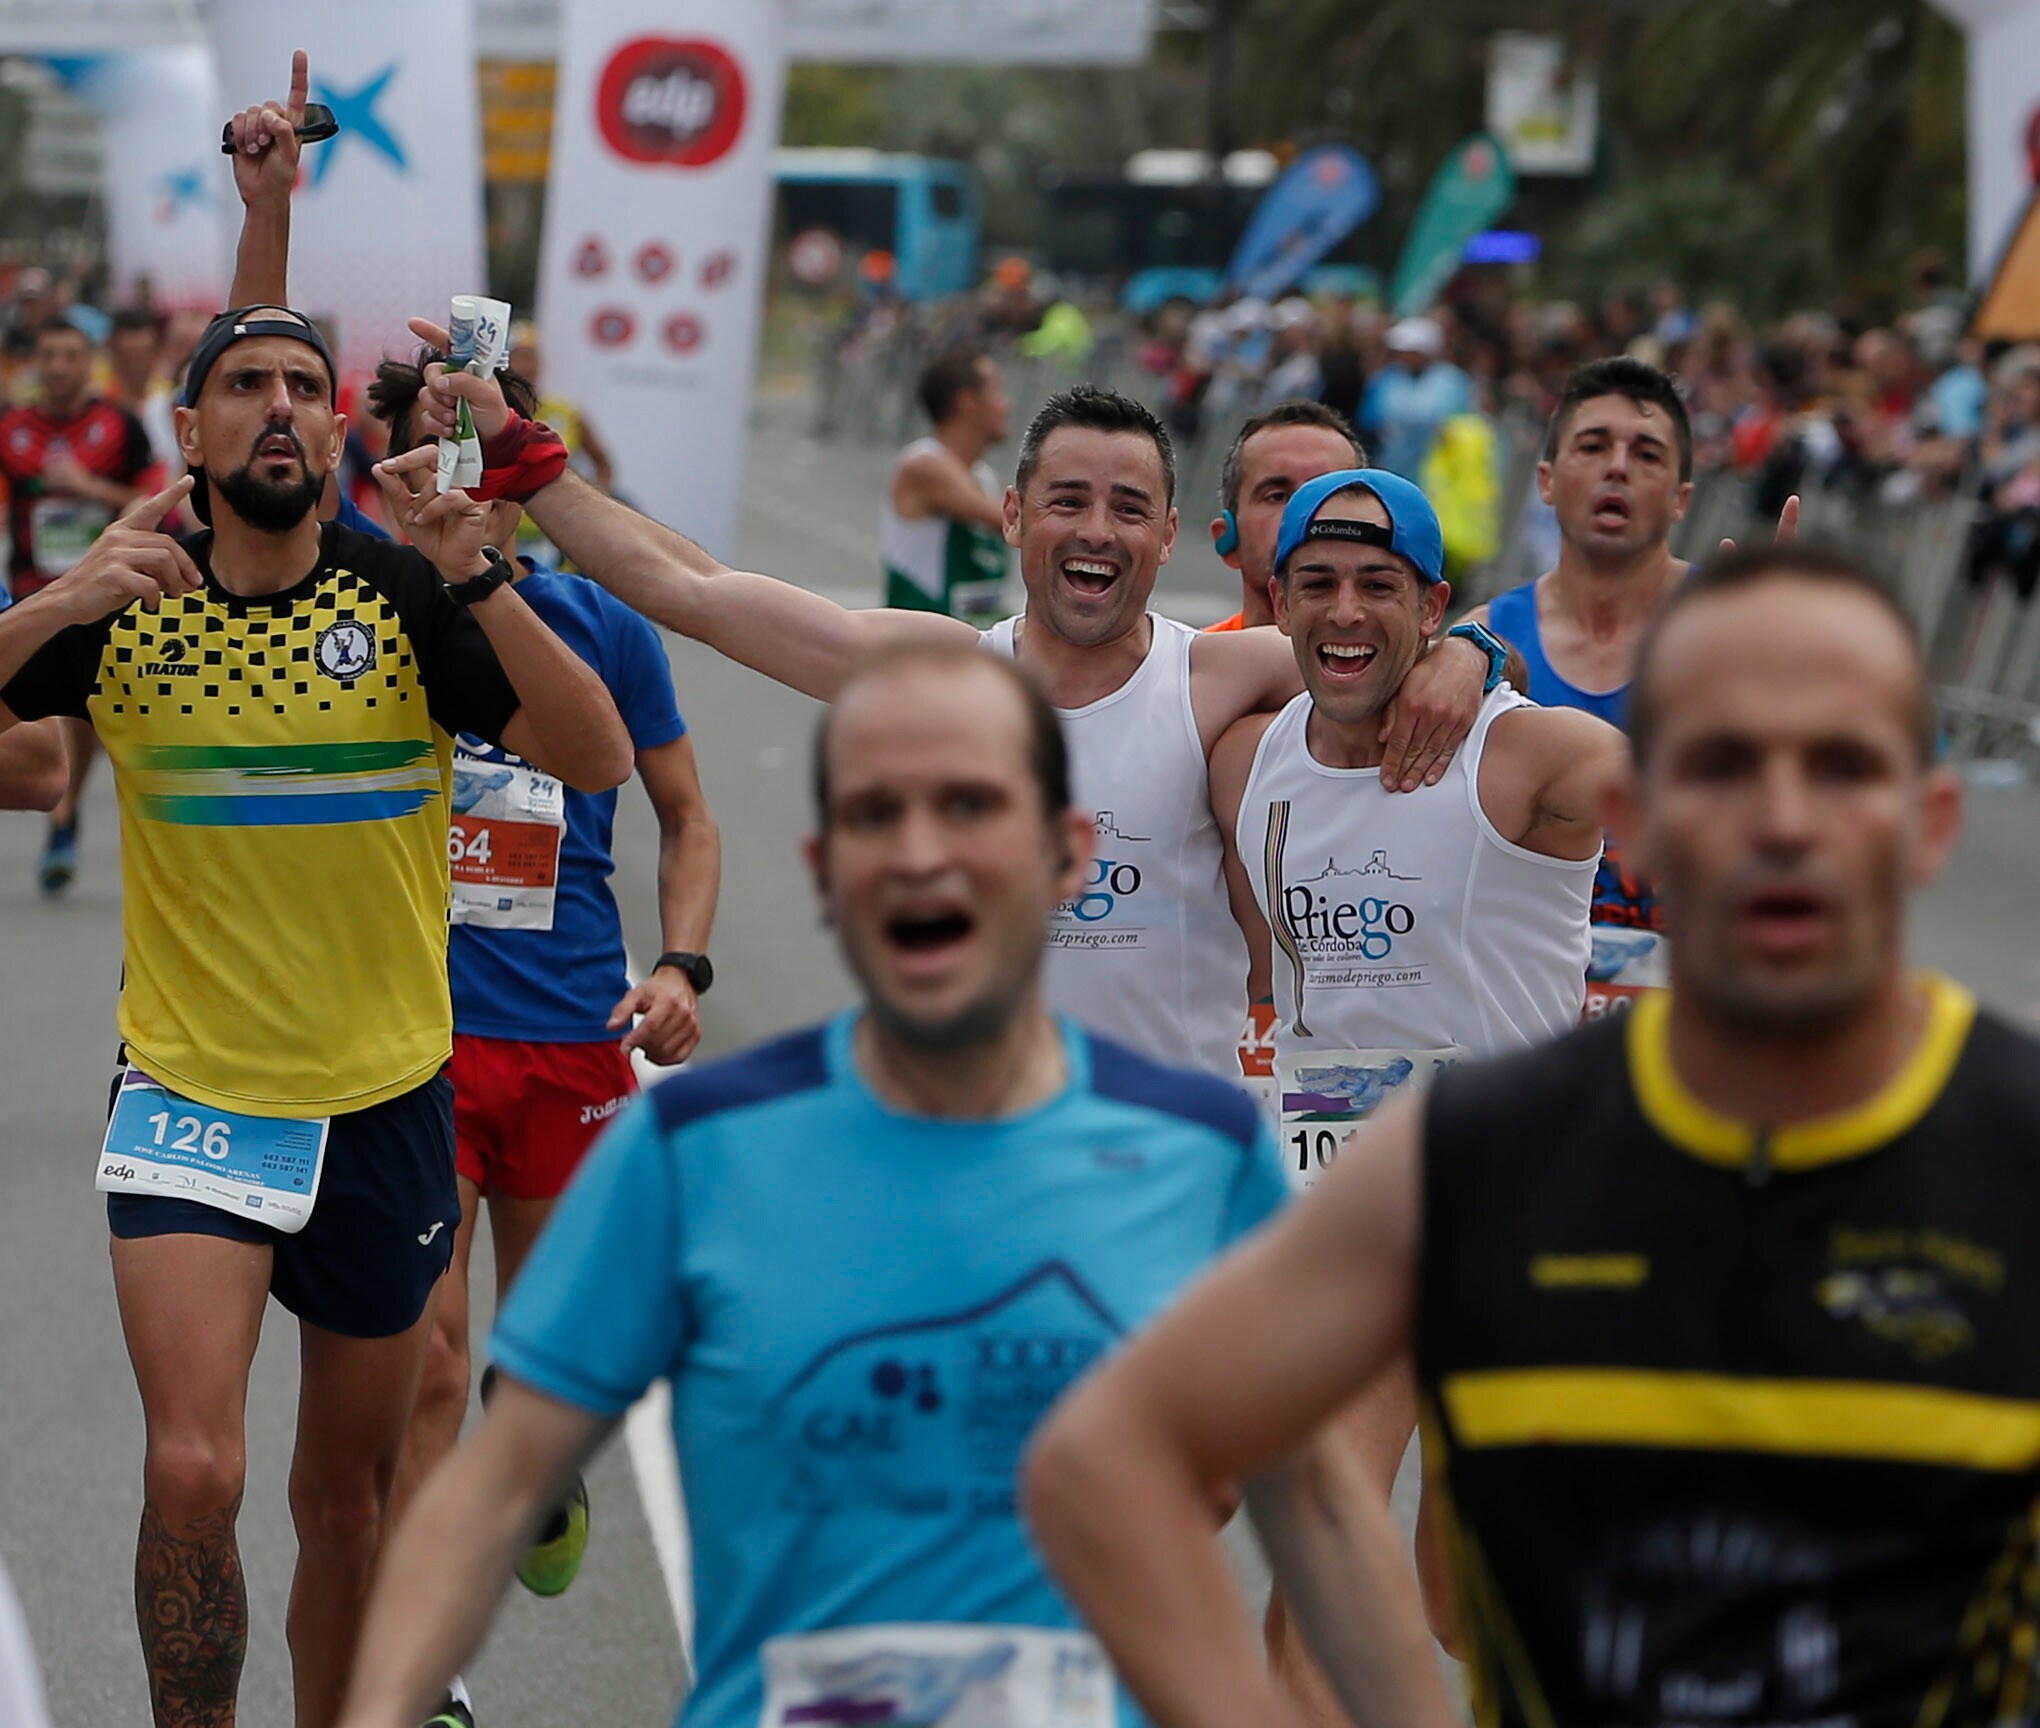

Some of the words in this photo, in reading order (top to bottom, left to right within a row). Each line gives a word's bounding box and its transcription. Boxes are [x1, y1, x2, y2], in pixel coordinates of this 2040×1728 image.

[1318, 524, 1361, 536] Columbia
[1284, 885, 1416, 960] Priego
[148, 1111, 232, 1160] 126
[103, 1164, 136, 1182] edp
[133, 1145, 154, 1156] JOSE
[155, 1150, 190, 1163] CARLOS
[190, 1158, 226, 1172] PALOMO
[227, 1168, 261, 1180] ARENAS
